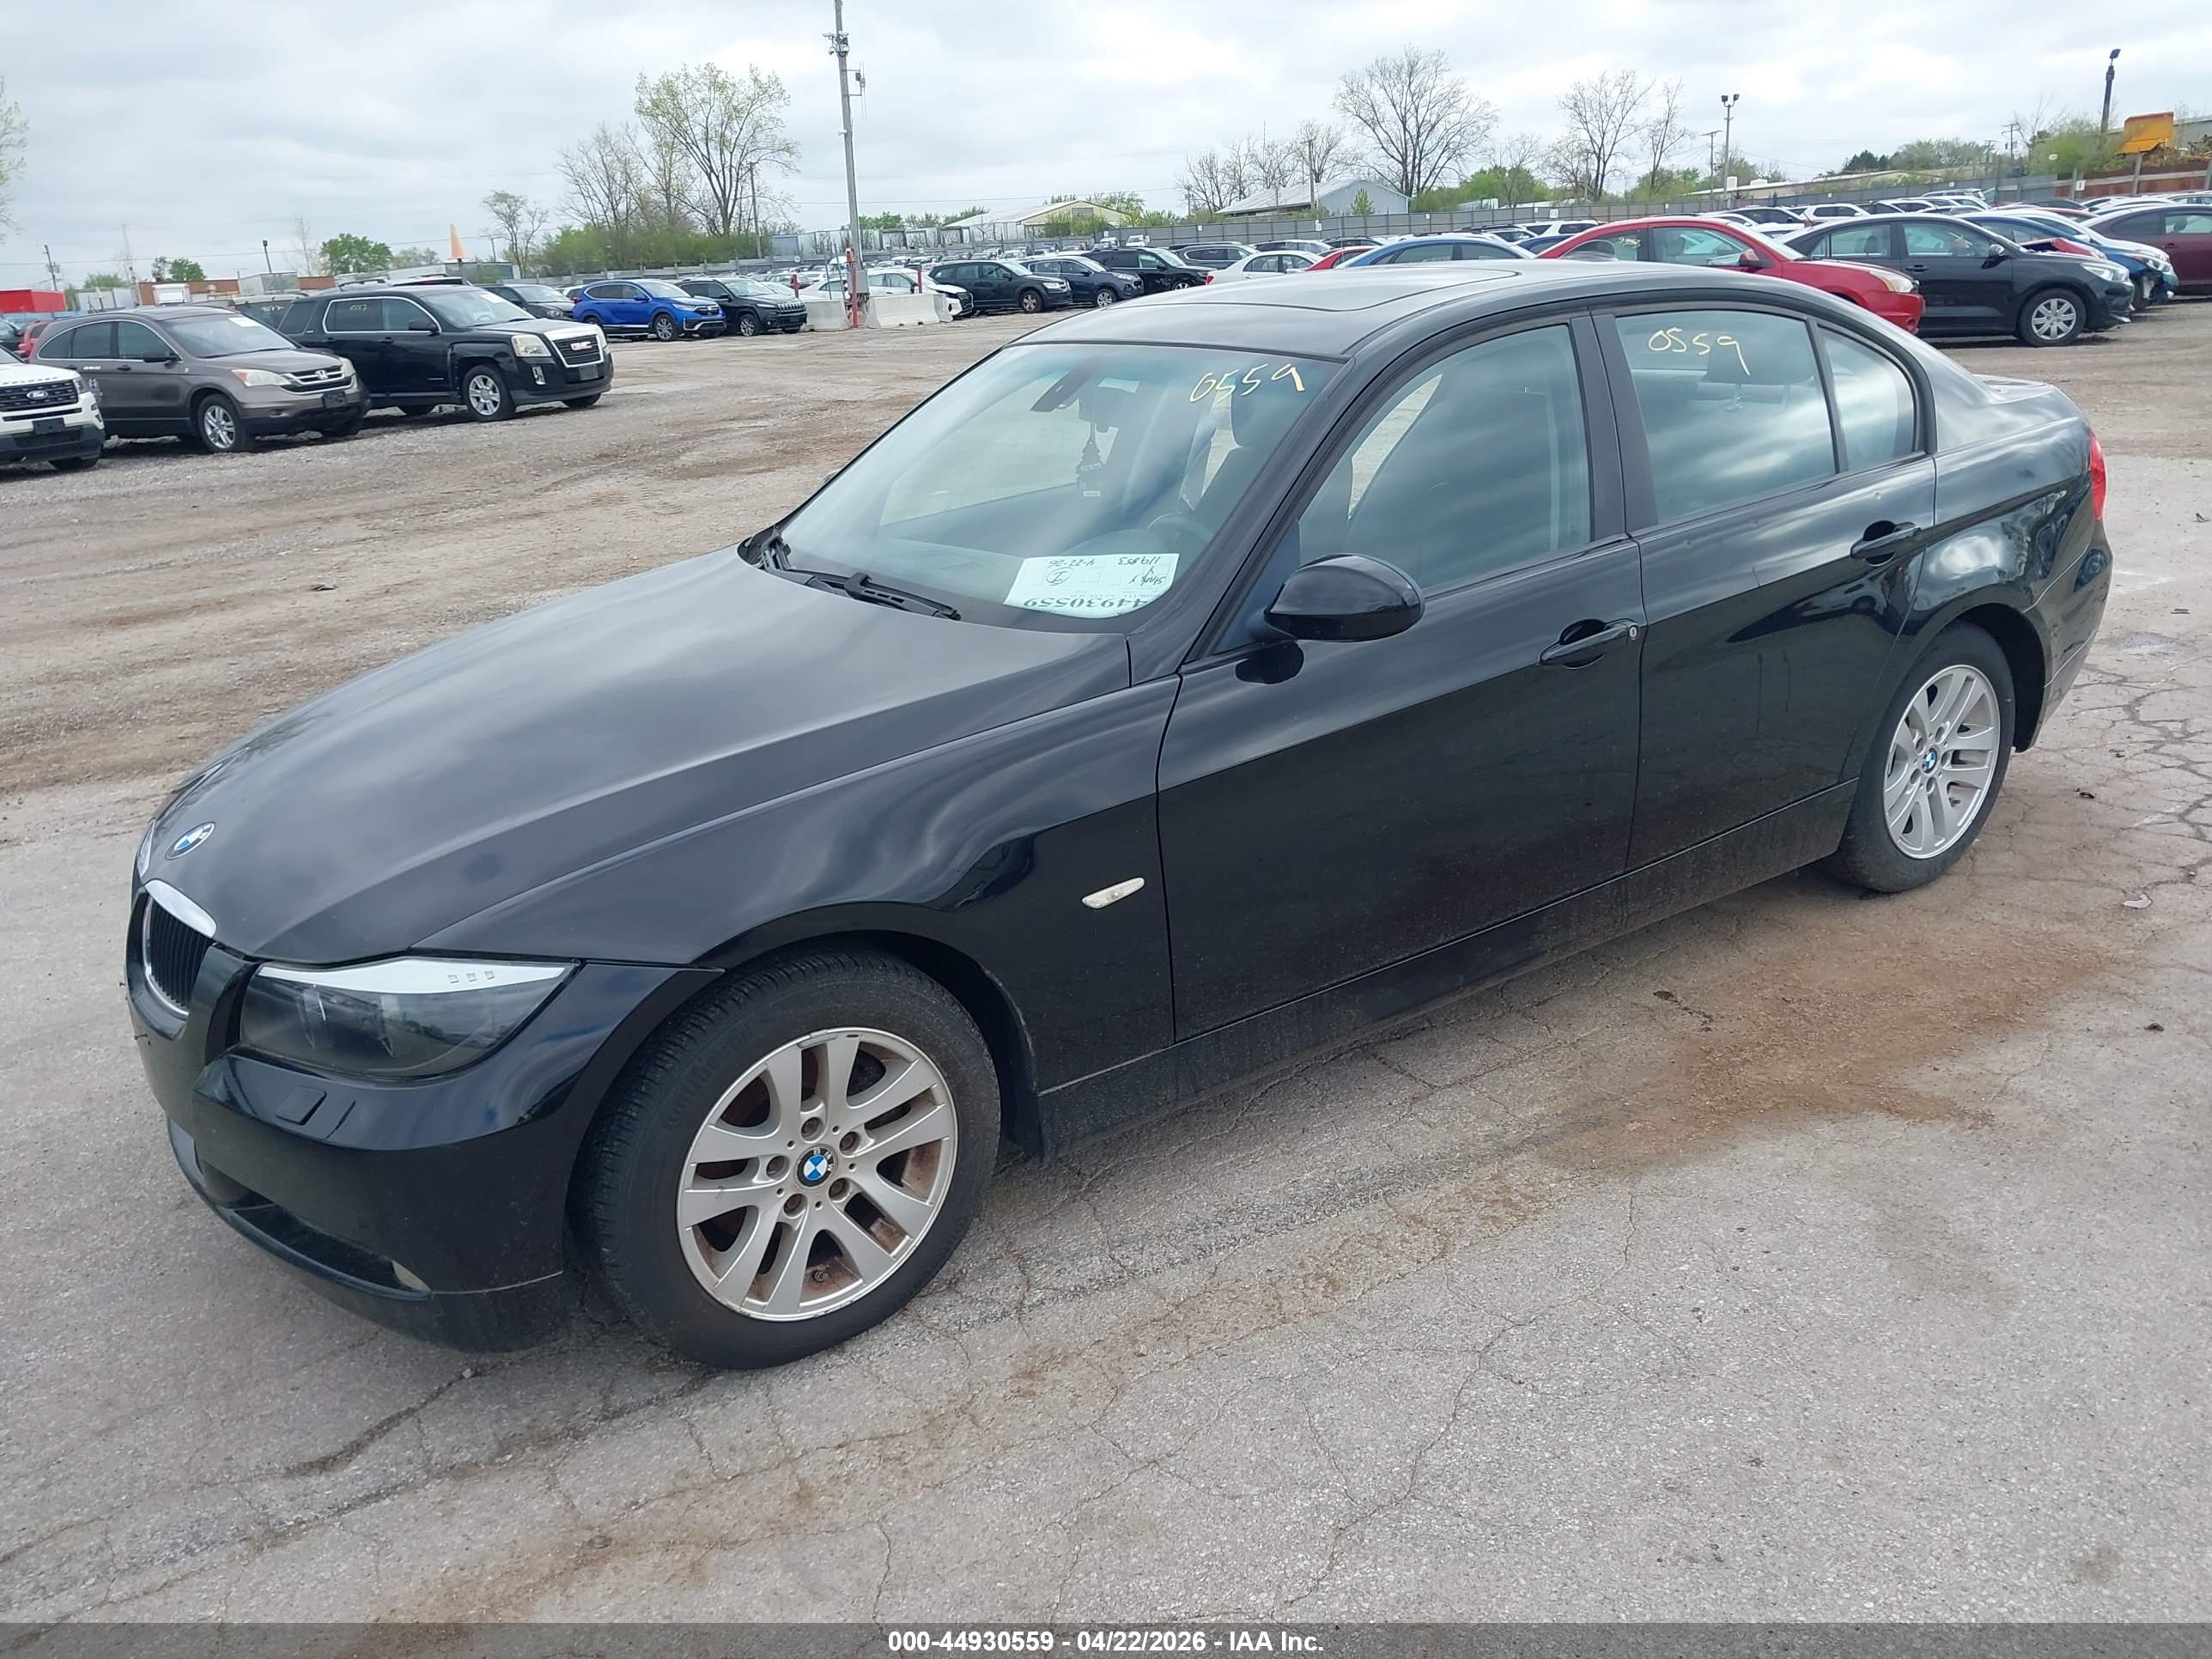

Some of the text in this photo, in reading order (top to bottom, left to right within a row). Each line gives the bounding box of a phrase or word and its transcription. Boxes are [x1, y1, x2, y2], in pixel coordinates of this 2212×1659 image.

[1648, 327, 1751, 376] 0559
[1190, 363, 1305, 403] 0559
[1023, 598, 1148, 608] 44930559
